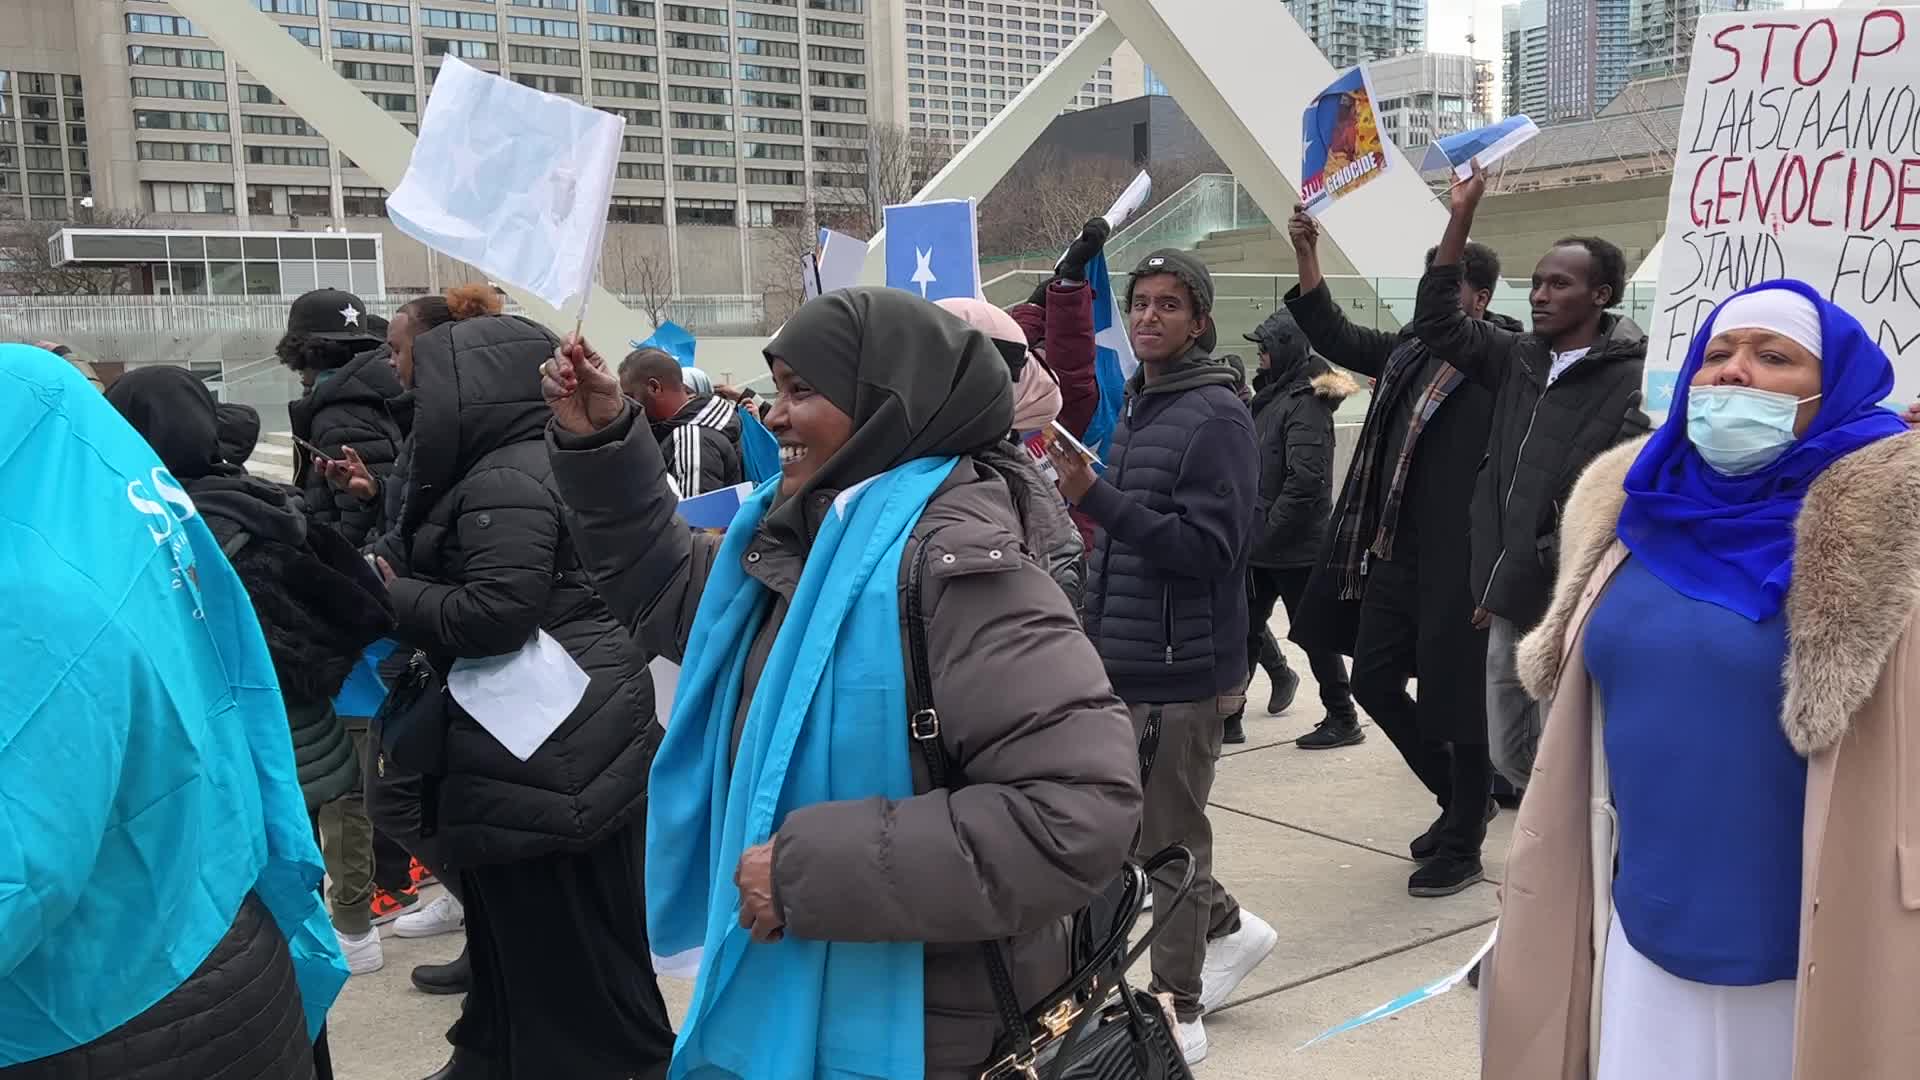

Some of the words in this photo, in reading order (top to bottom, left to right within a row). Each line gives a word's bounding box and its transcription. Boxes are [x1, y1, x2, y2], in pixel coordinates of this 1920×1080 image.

[1708, 9, 1905, 86] STOP
[1326, 151, 1378, 194] GENOCIDE
[1690, 150, 1920, 231] GENOCIDE
[1670, 231, 1785, 296] STAND
[1830, 235, 1920, 307] FOR
